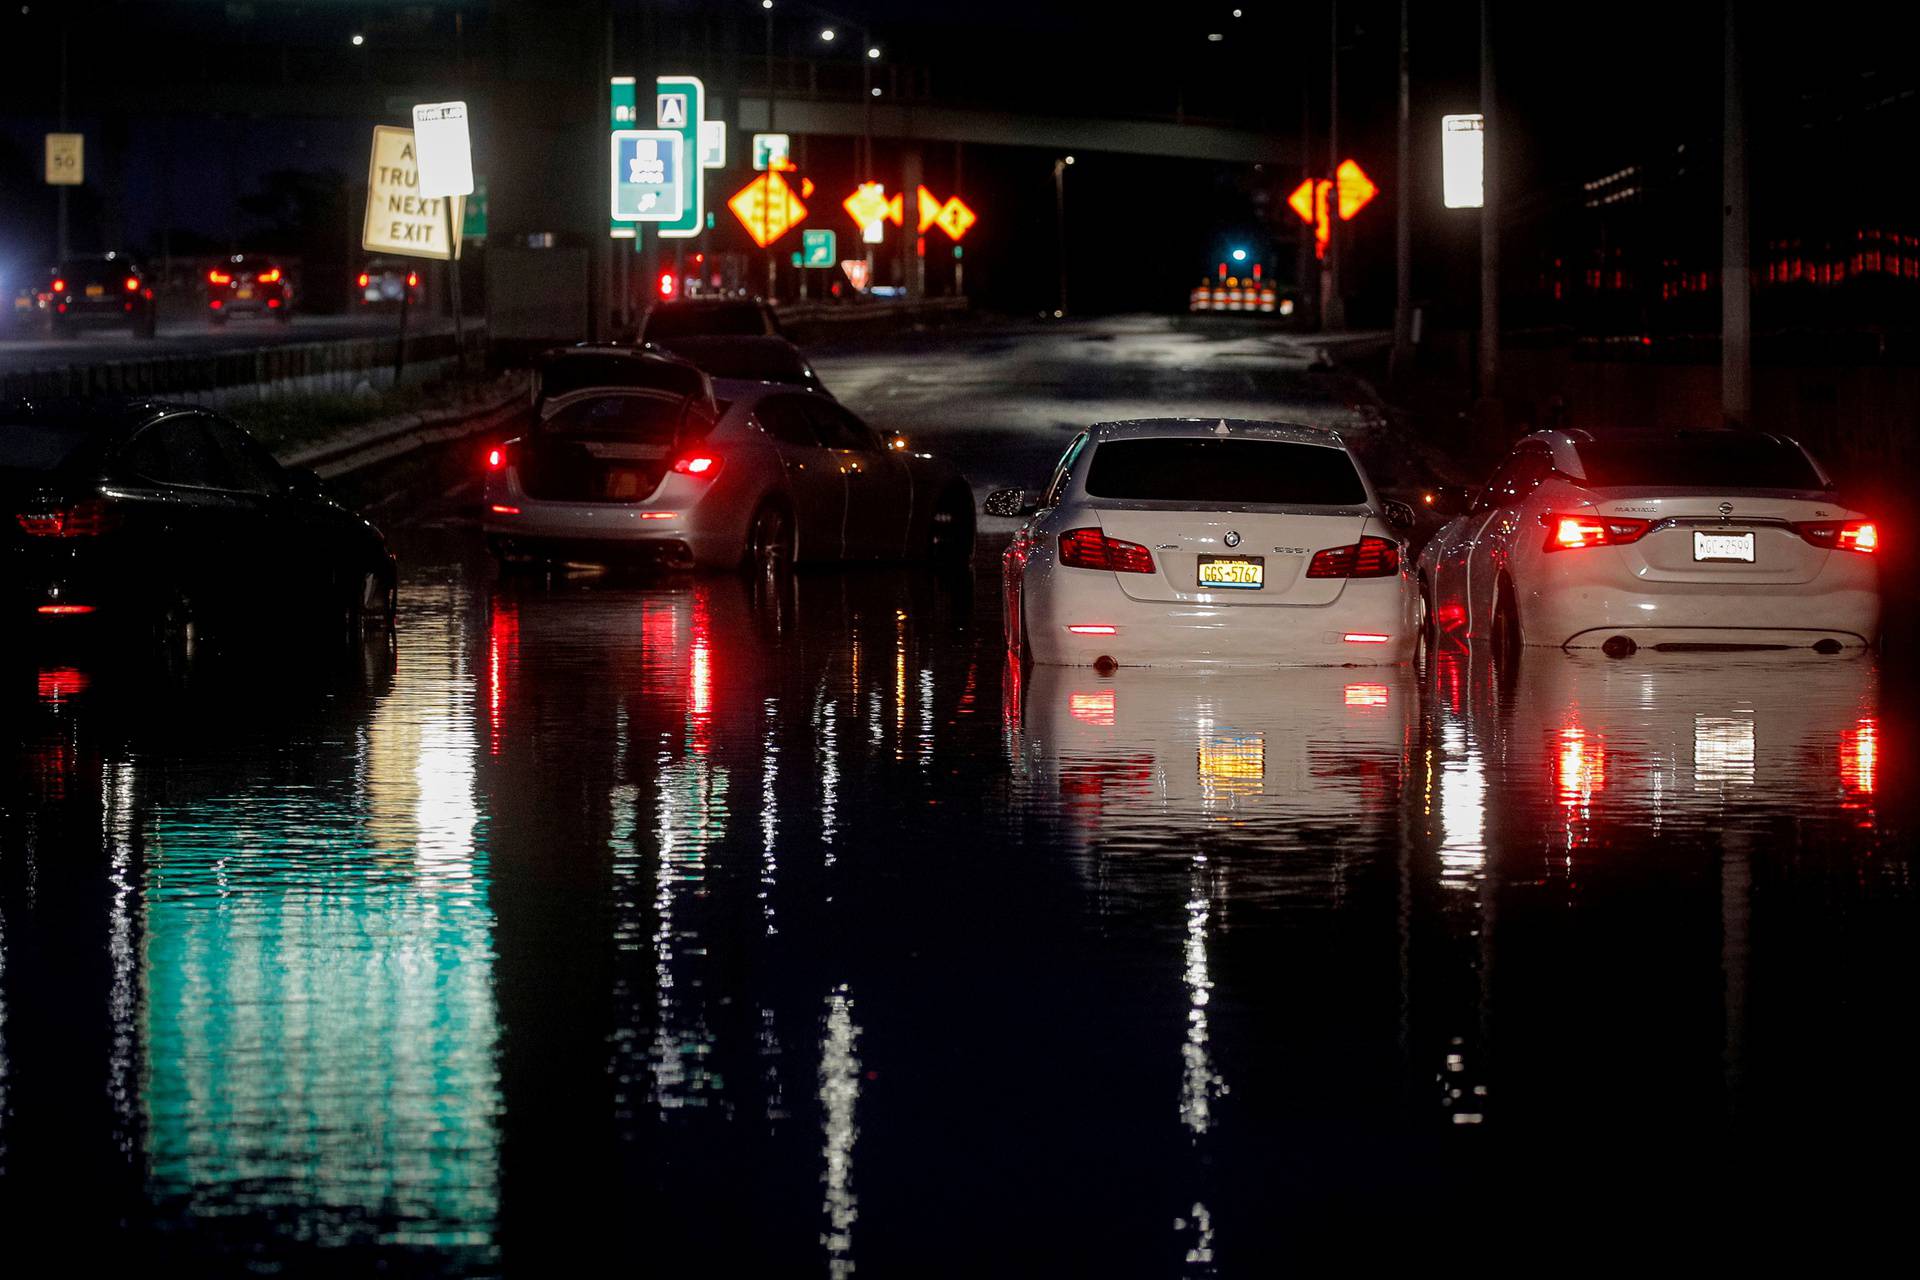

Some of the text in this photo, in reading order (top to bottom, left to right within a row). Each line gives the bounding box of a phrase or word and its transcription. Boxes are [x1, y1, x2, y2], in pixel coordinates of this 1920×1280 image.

[379, 166, 419, 187] TRU
[388, 195, 440, 217] NEXT
[390, 221, 433, 242] EXIT
